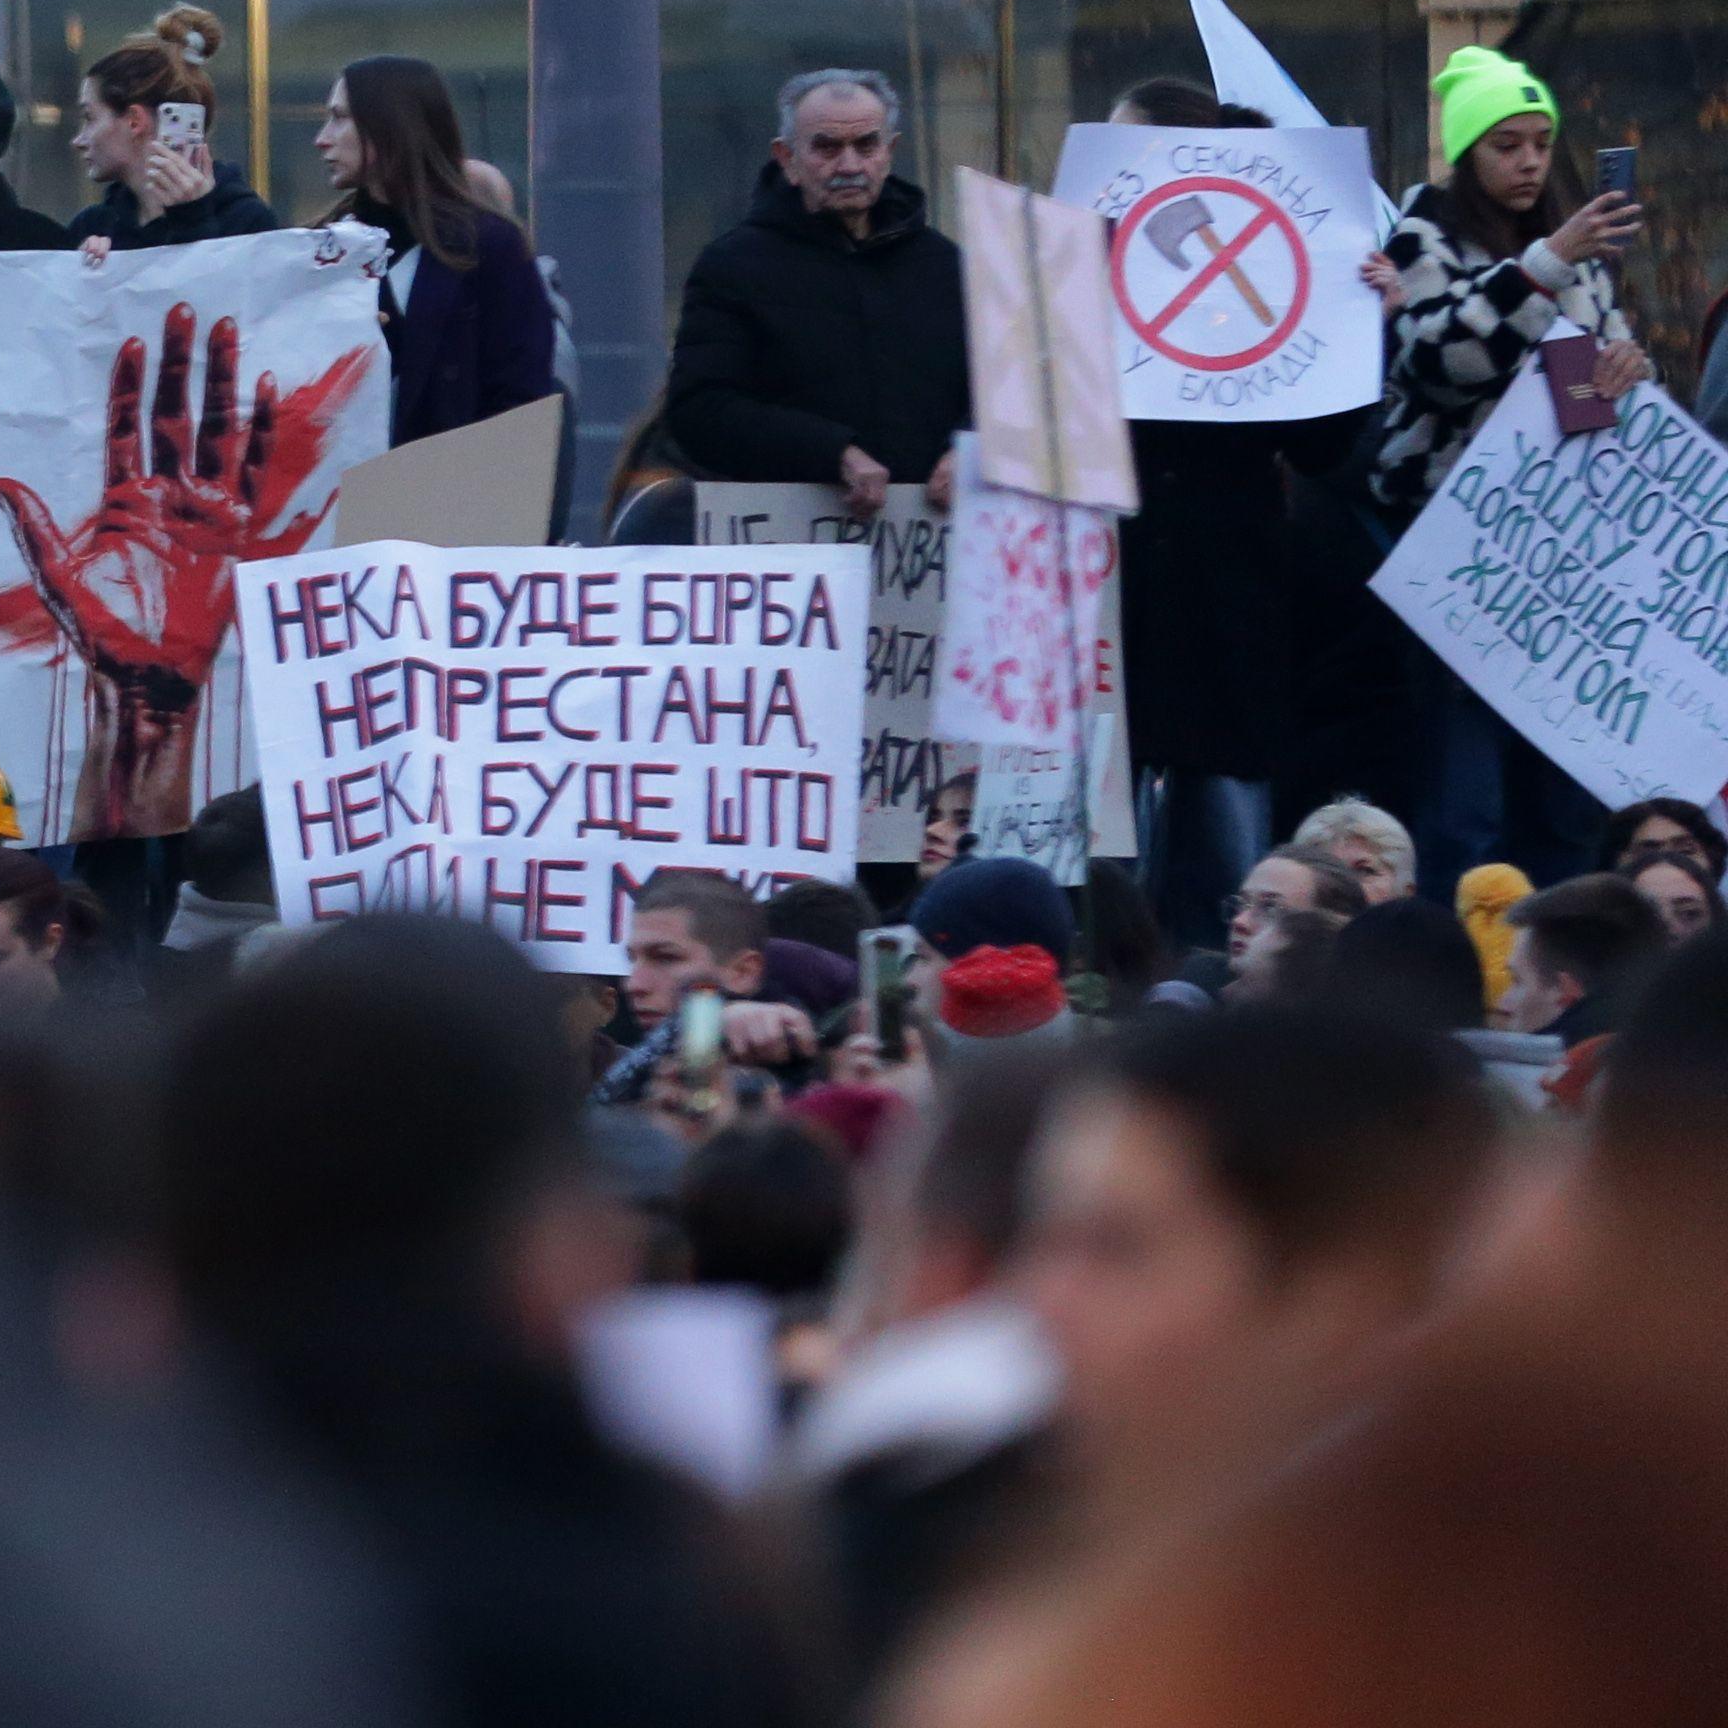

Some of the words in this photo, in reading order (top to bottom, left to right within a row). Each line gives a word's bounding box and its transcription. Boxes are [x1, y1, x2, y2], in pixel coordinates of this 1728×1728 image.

[1170, 143, 1333, 236] СЕКИРАЊА
[1123, 342, 1154, 375] У
[1178, 328, 1329, 407] БЛОКАДИ
[266, 562, 433, 664] НЕКА
[449, 570, 621, 649] БУДЕ
[641, 571, 841, 652] БОРБА
[1449, 465, 1648, 667] ДОМОВИНА
[1447, 538, 1649, 745] ЖИВОТОМ
[314, 656, 820, 758] НЕПРЕСТАНА,
[292, 751, 454, 861] НЕКА
[481, 761, 680, 842] БУДЕ
[706, 765, 834, 854] ШТО
[485, 856, 588, 944] НЕ
